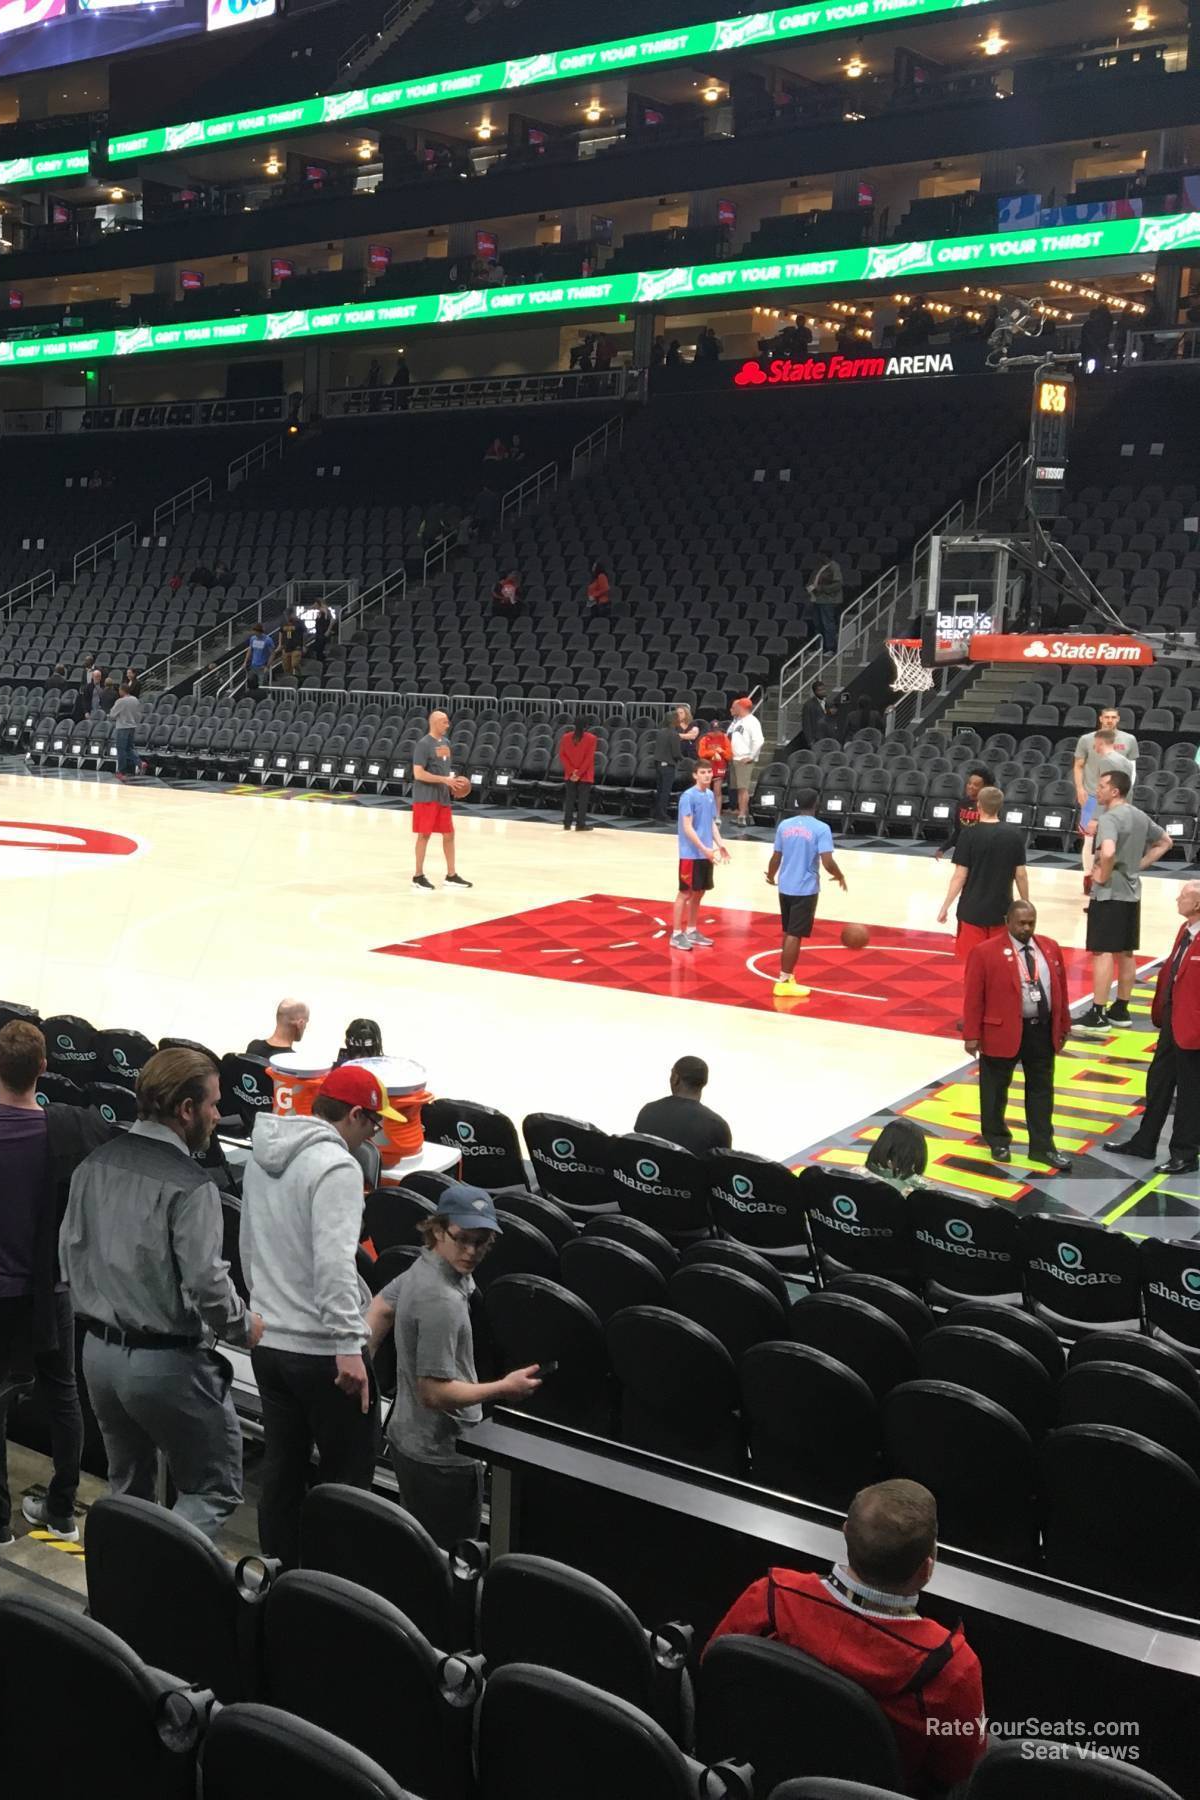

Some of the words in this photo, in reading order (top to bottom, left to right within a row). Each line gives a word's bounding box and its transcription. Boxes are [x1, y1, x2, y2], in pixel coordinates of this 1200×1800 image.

[560, 53, 596, 70] OBEY
[600, 45, 637, 62] YOUR
[640, 36, 688, 55] THIRST
[779, 11, 821, 30] OBEY
[826, 2, 868, 21] YOUR
[16, 347, 40, 359] OBEY
[43, 343, 67, 354] YOUR
[68, 339, 99, 352] THIRST
[155, 331, 181, 343] OBEY
[184, 328, 211, 341] YOUR
[213, 323, 248, 337] THIRST
[312, 311, 343, 328] OBEY
[344, 308, 375, 324] YOUR
[377, 305, 417, 319] THIRST
[490, 294, 525, 308] OBEY
[529, 289, 564, 304] YOUR
[567, 284, 612, 300] THIRST
[697, 270, 736, 287] OBEY
[741, 266, 781, 281] YOUR
[785, 260, 838, 277] THIRST
[937, 244, 983, 262] OBEY
[990, 239, 1036, 256] YOUR
[1041, 231, 1103, 251] THIRST
[886, 353, 954, 376] ARENA
[276, 1087, 293, 1109] G
[533, 1148, 605, 1176] sharecare
[613, 1168, 691, 1200] sharecare
[711, 1185, 788, 1216] sharecare
[810, 1207, 894, 1239] sharecare
[916, 1227, 1011, 1263] sharecare
[1029, 1256, 1122, 1287] sharecare
